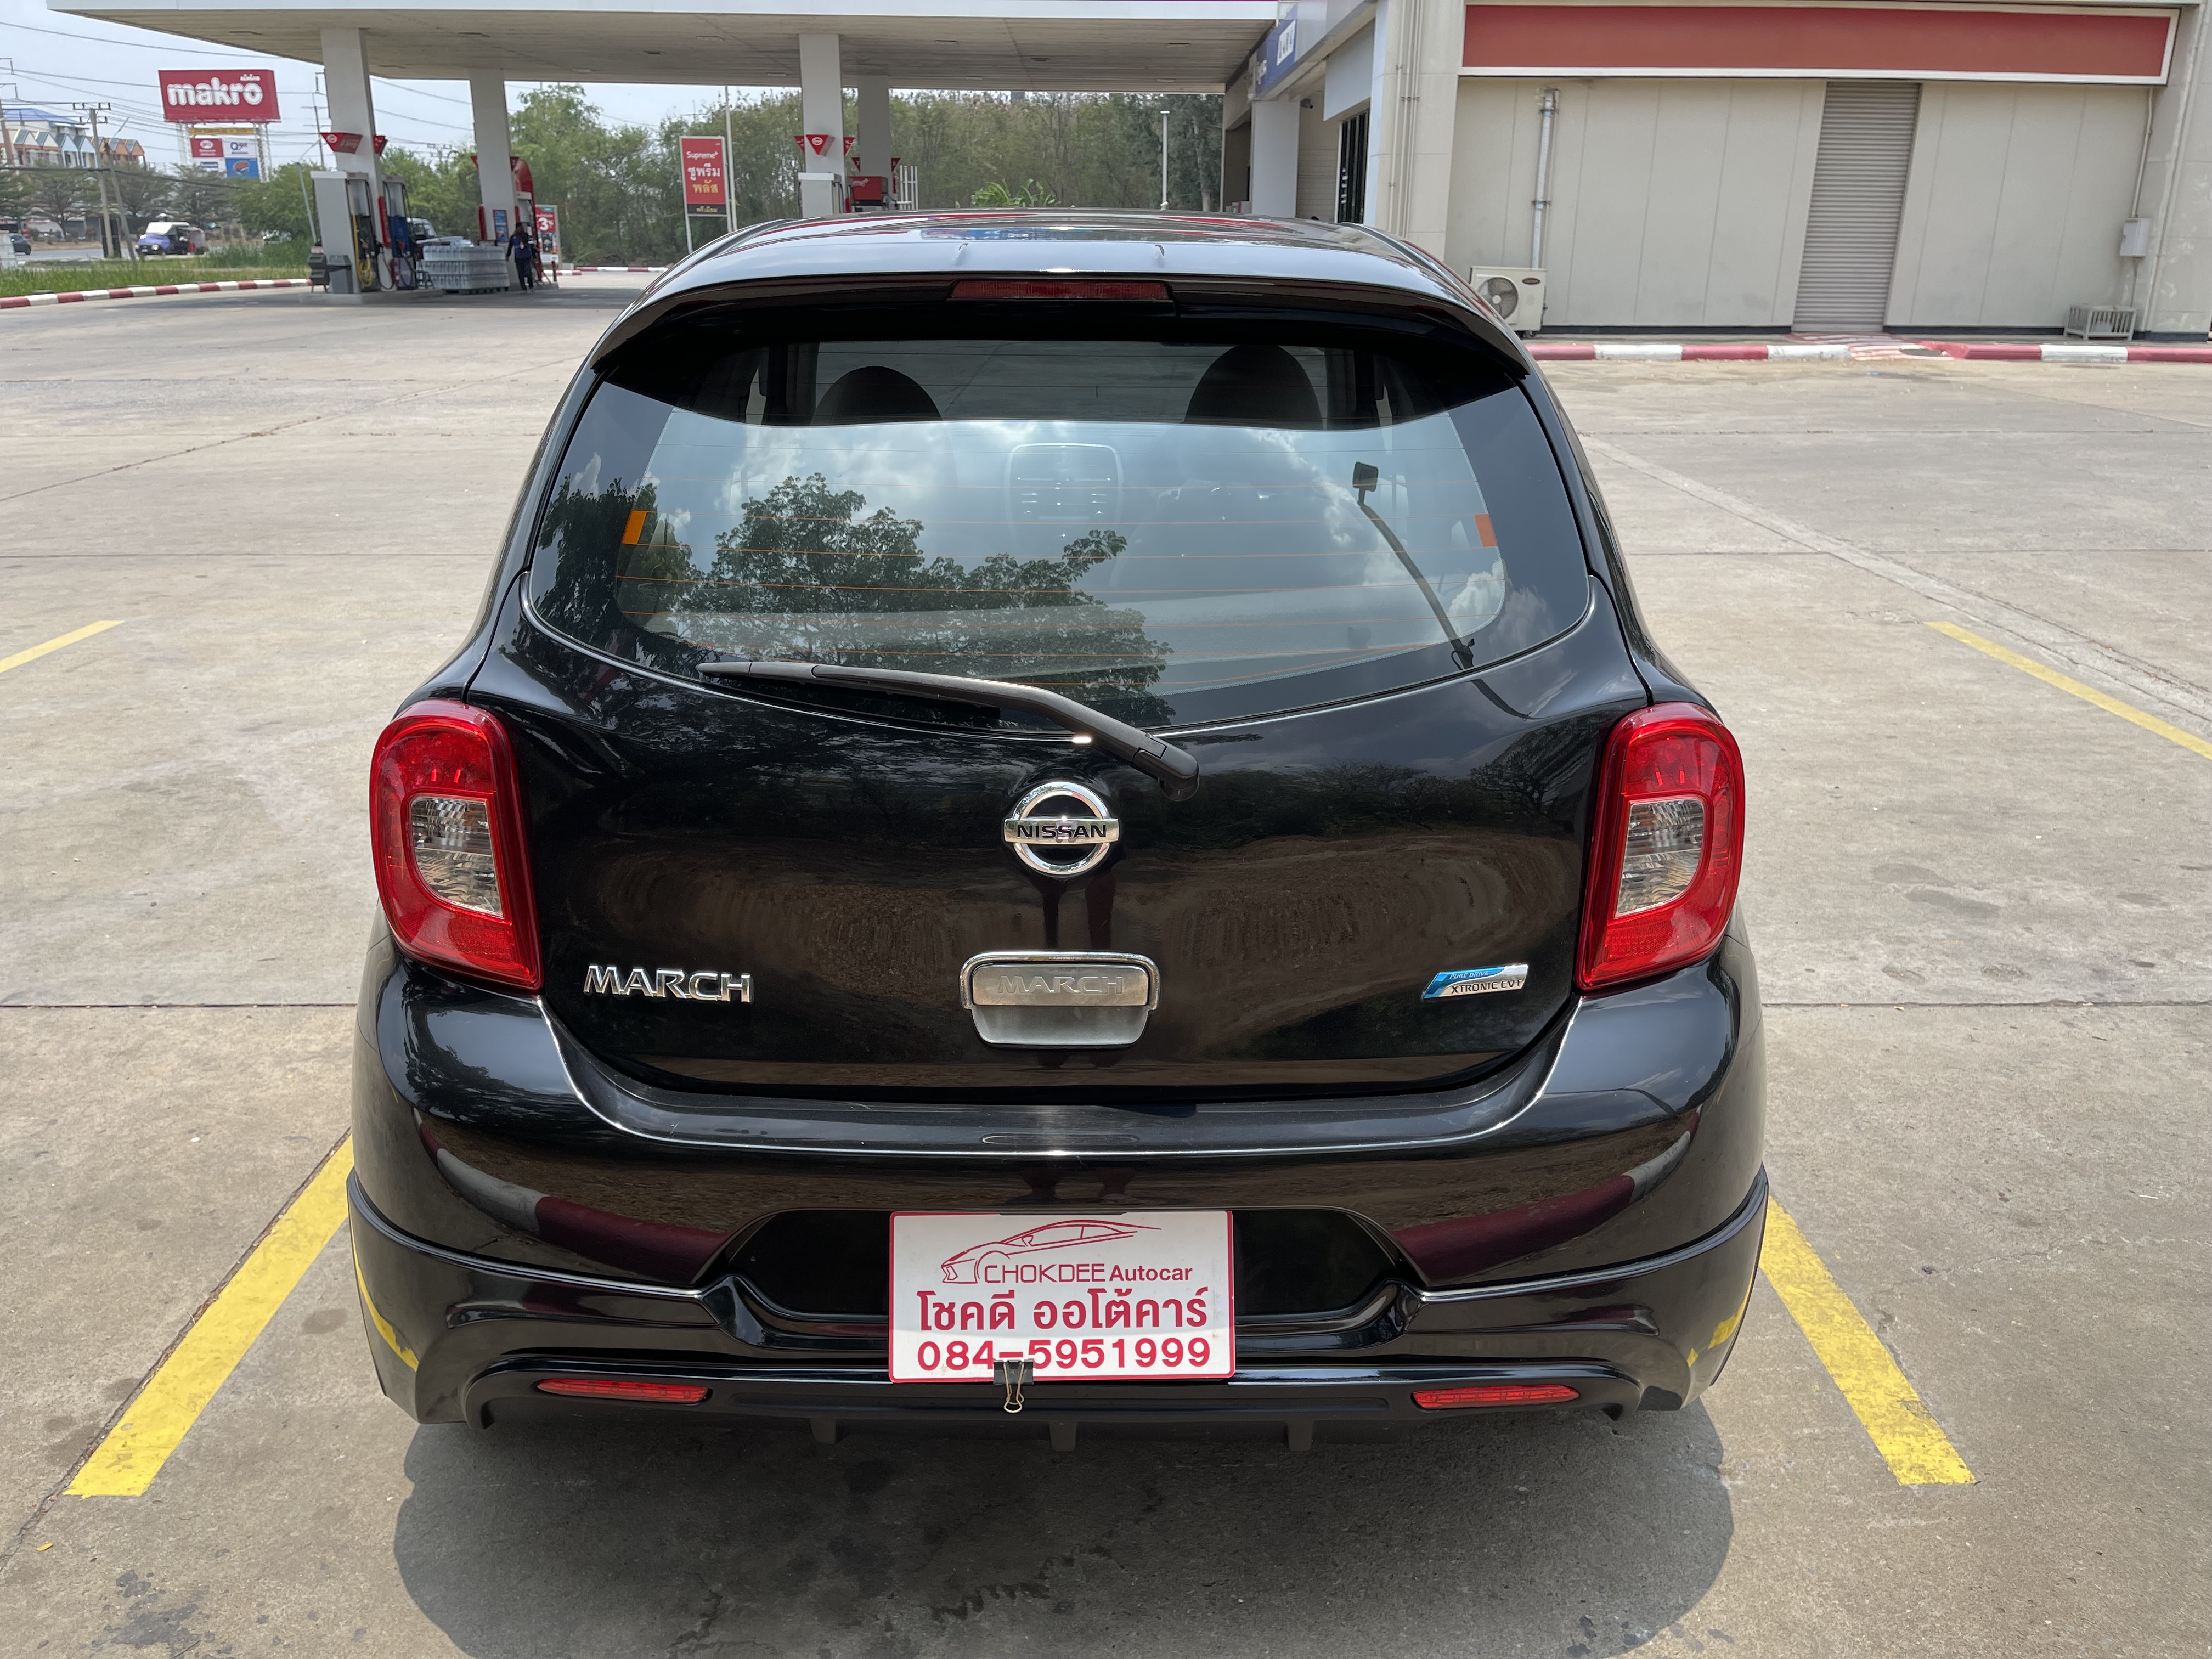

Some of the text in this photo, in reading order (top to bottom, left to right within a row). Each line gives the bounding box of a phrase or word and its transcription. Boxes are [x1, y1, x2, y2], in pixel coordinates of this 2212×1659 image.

[167, 77, 263, 105] makro
[687, 162, 720, 181] ซูพรีม
[692, 179, 719, 193] พลัส
[1017, 824, 1107, 839] NISSAN
[583, 965, 752, 1003] MARCH
[997, 975, 1124, 994] MARCH
[1451, 979, 1522, 994] XTRONIC CVT
[984, 1263, 1193, 1283] CHOKDEE Autocar
[916, 1286, 1209, 1331] โชคดี ออโต้คาร์
[917, 1337, 1211, 1371] 084-5951999
